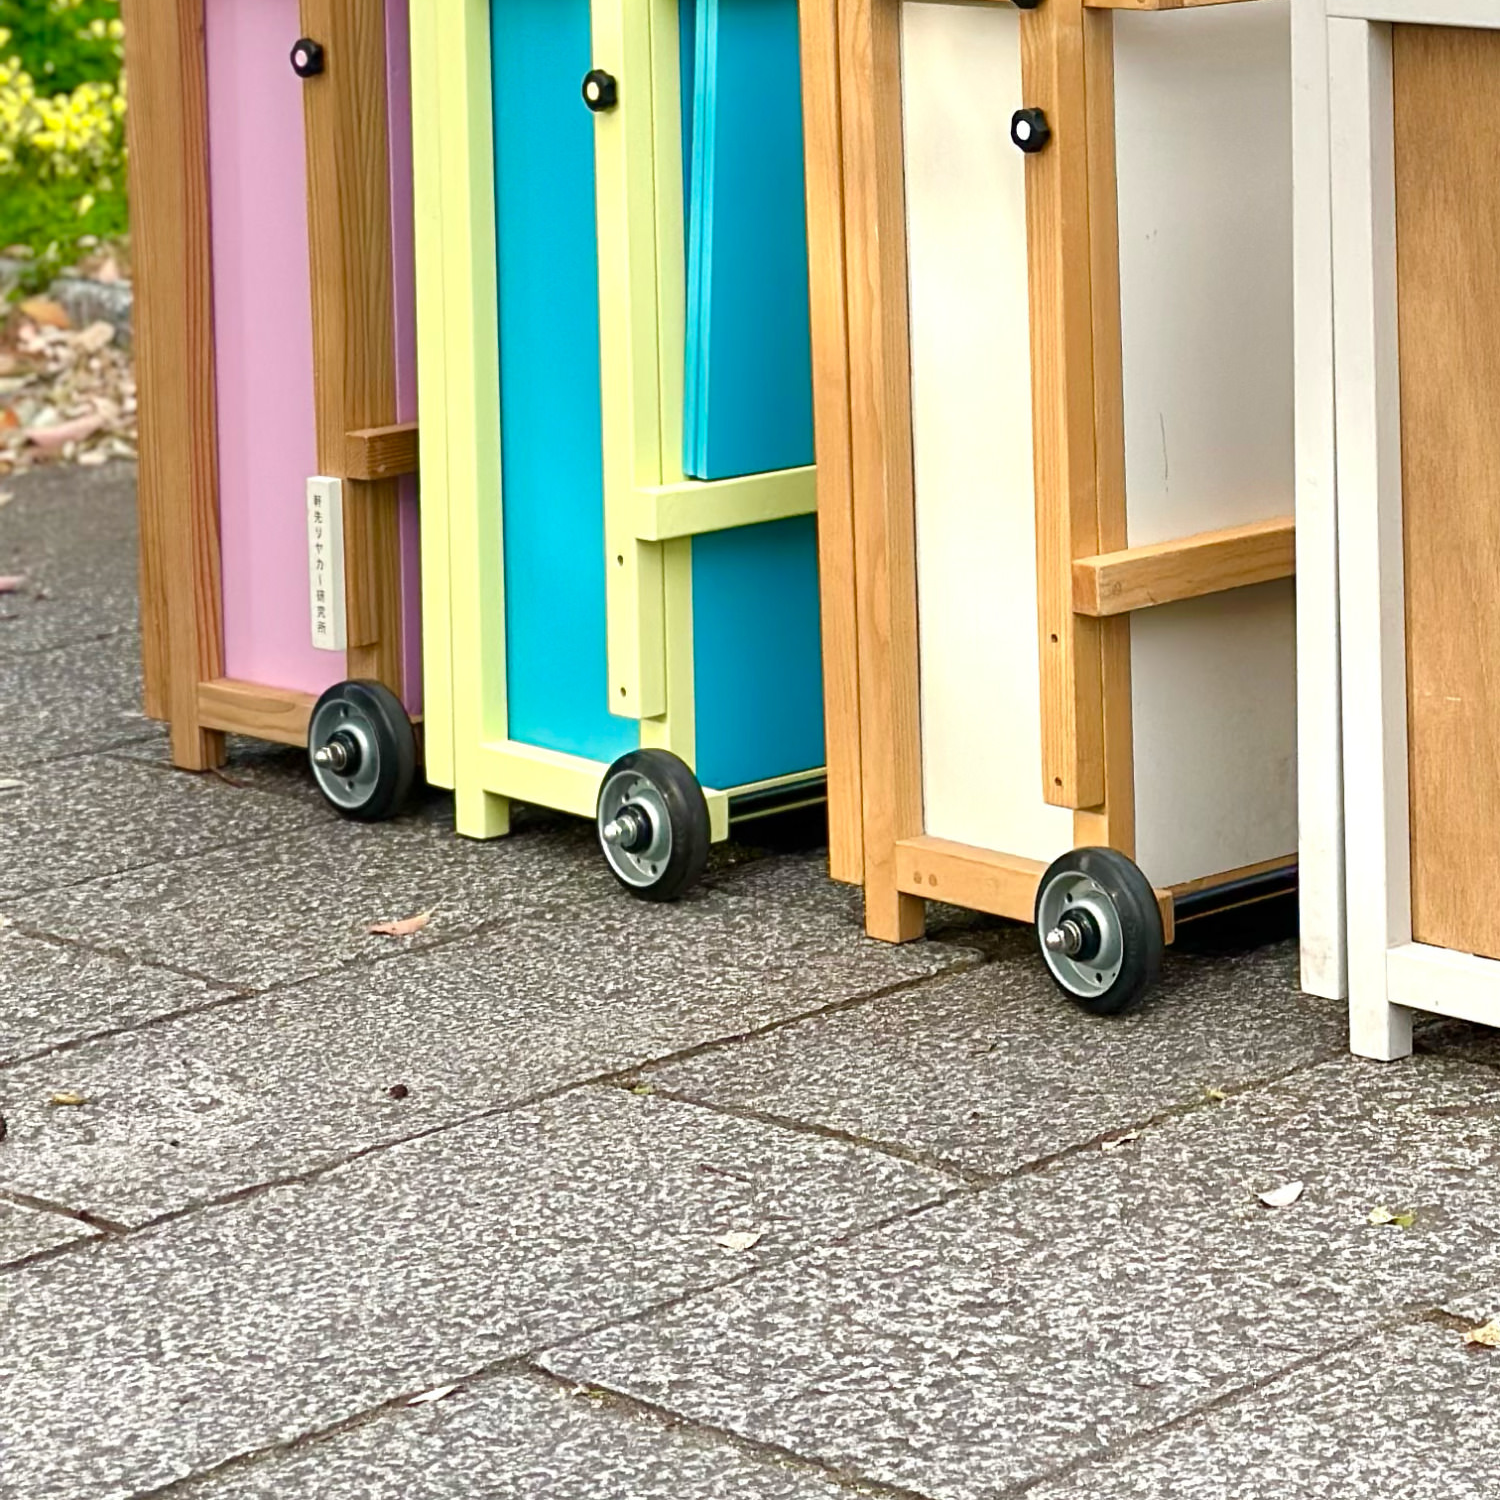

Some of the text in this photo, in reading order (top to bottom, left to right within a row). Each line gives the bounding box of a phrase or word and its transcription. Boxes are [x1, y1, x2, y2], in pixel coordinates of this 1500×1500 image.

[313, 494, 327, 635] 軒先リヤカー研究所
